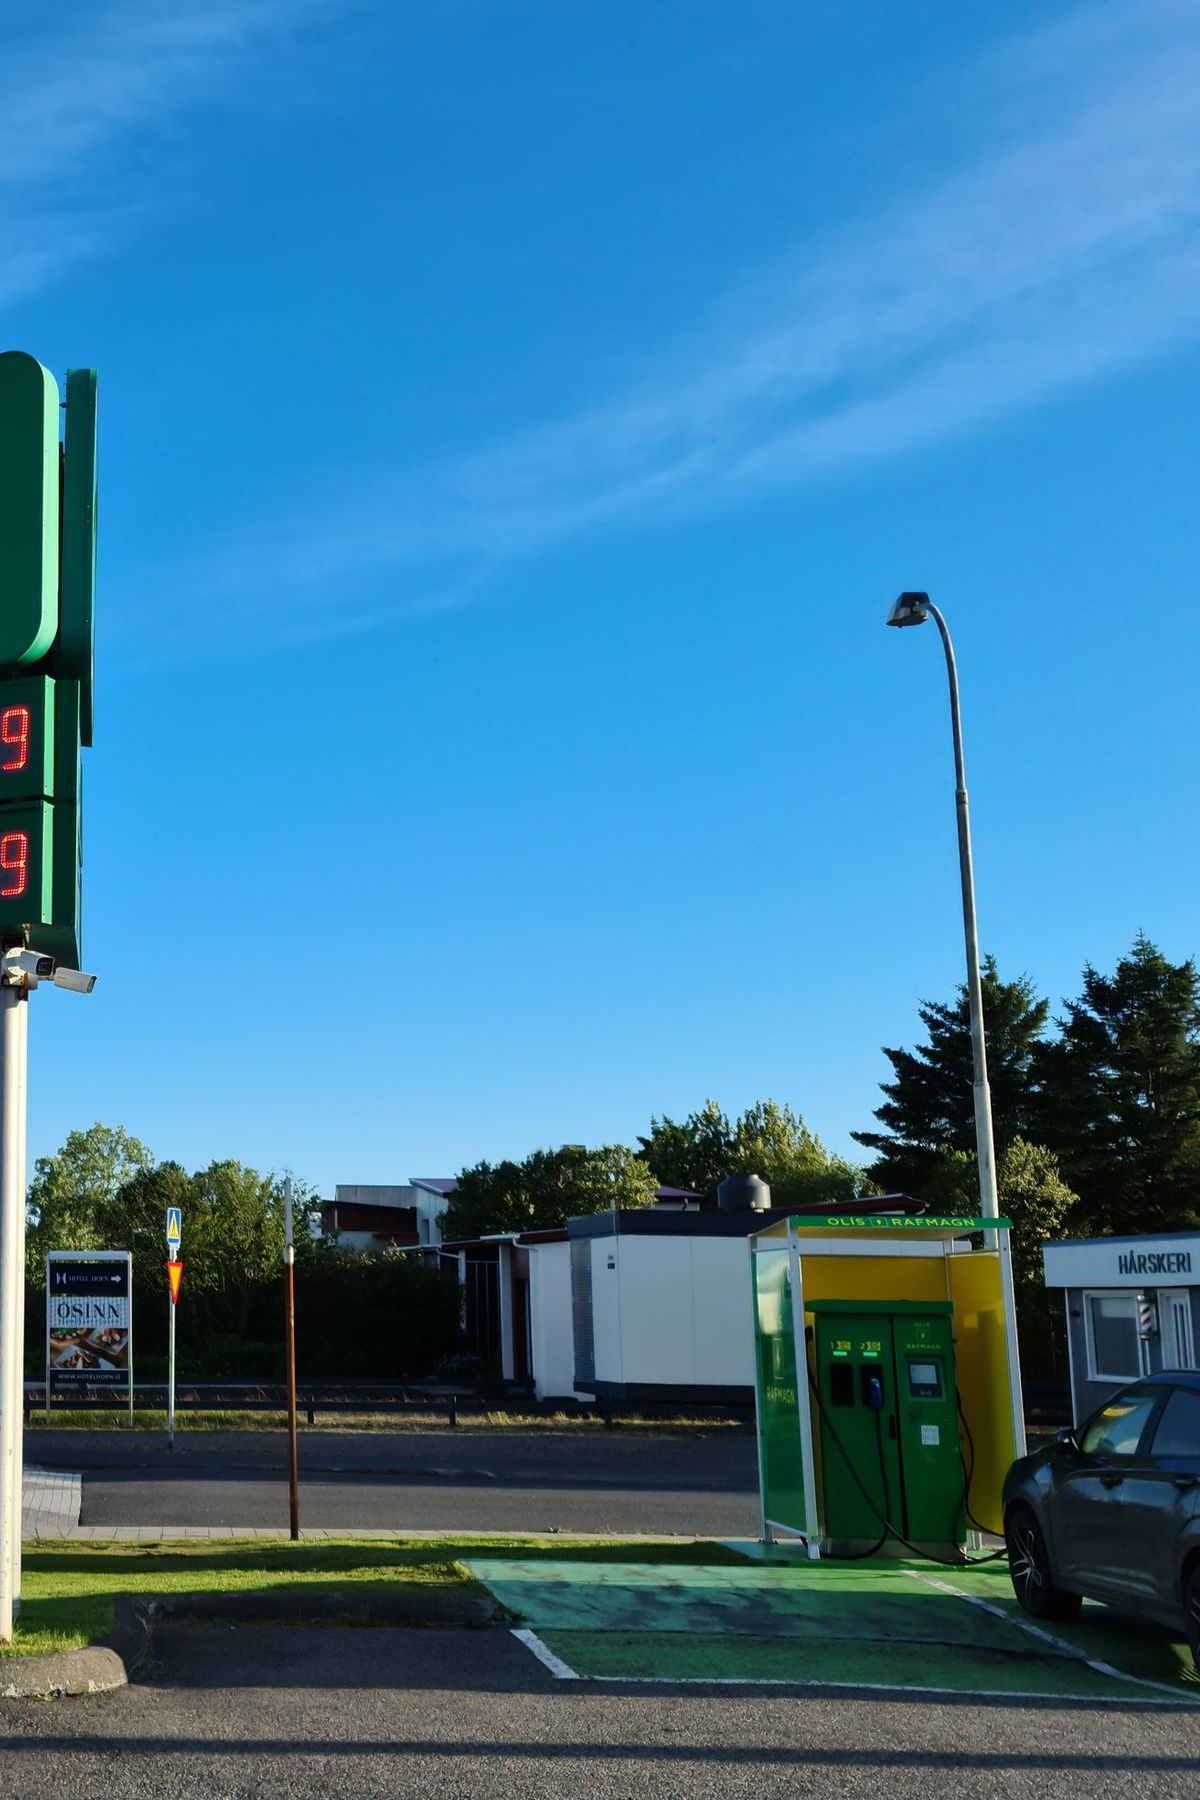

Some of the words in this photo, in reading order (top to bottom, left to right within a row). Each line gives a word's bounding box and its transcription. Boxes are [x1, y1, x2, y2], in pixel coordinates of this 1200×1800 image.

[1, 706, 29, 771] 9
[0, 832, 28, 896] 9
[891, 1217, 976, 1227] RAFMAGN
